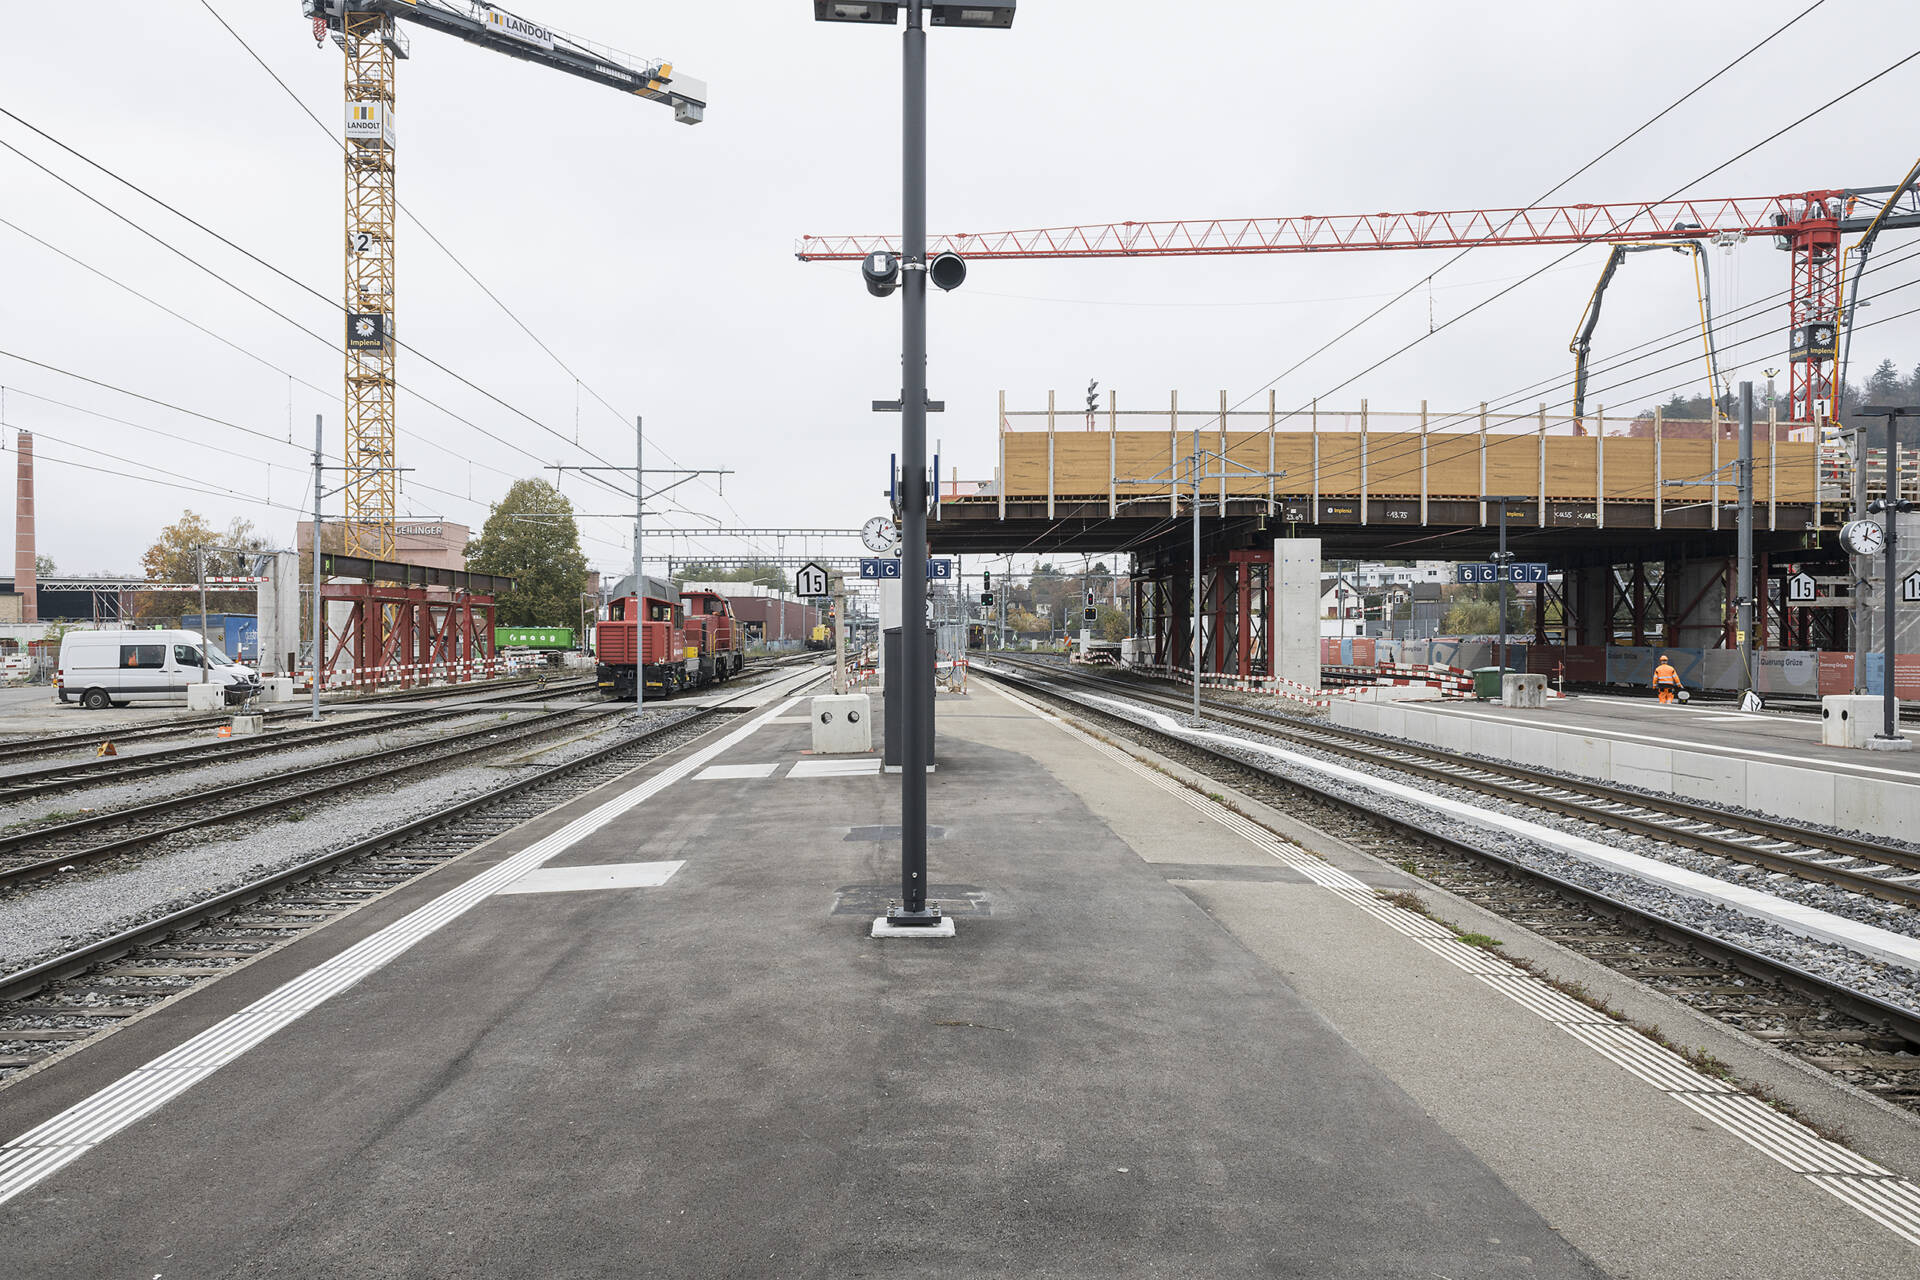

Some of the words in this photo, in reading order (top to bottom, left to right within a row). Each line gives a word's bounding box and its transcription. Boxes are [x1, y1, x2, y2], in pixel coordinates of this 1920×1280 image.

[506, 17, 553, 42] LANDOLT
[357, 234, 369, 251] 2
[350, 339, 381, 347] Implenia
[1797, 403, 1802, 417] 1
[1817, 401, 1824, 415] 1
[866, 565, 874, 575] 4
[886, 565, 894, 575] C
[937, 565, 945, 576] 5
[1464, 569, 1472, 580] 6
[1483, 569, 1492, 580] C
[1514, 569, 1523, 580] C
[1534, 569, 1542, 580] 7
[803, 571, 822, 593] 15
[1794, 578, 1811, 598] 15
[1761, 658, 1784, 667] Querung
